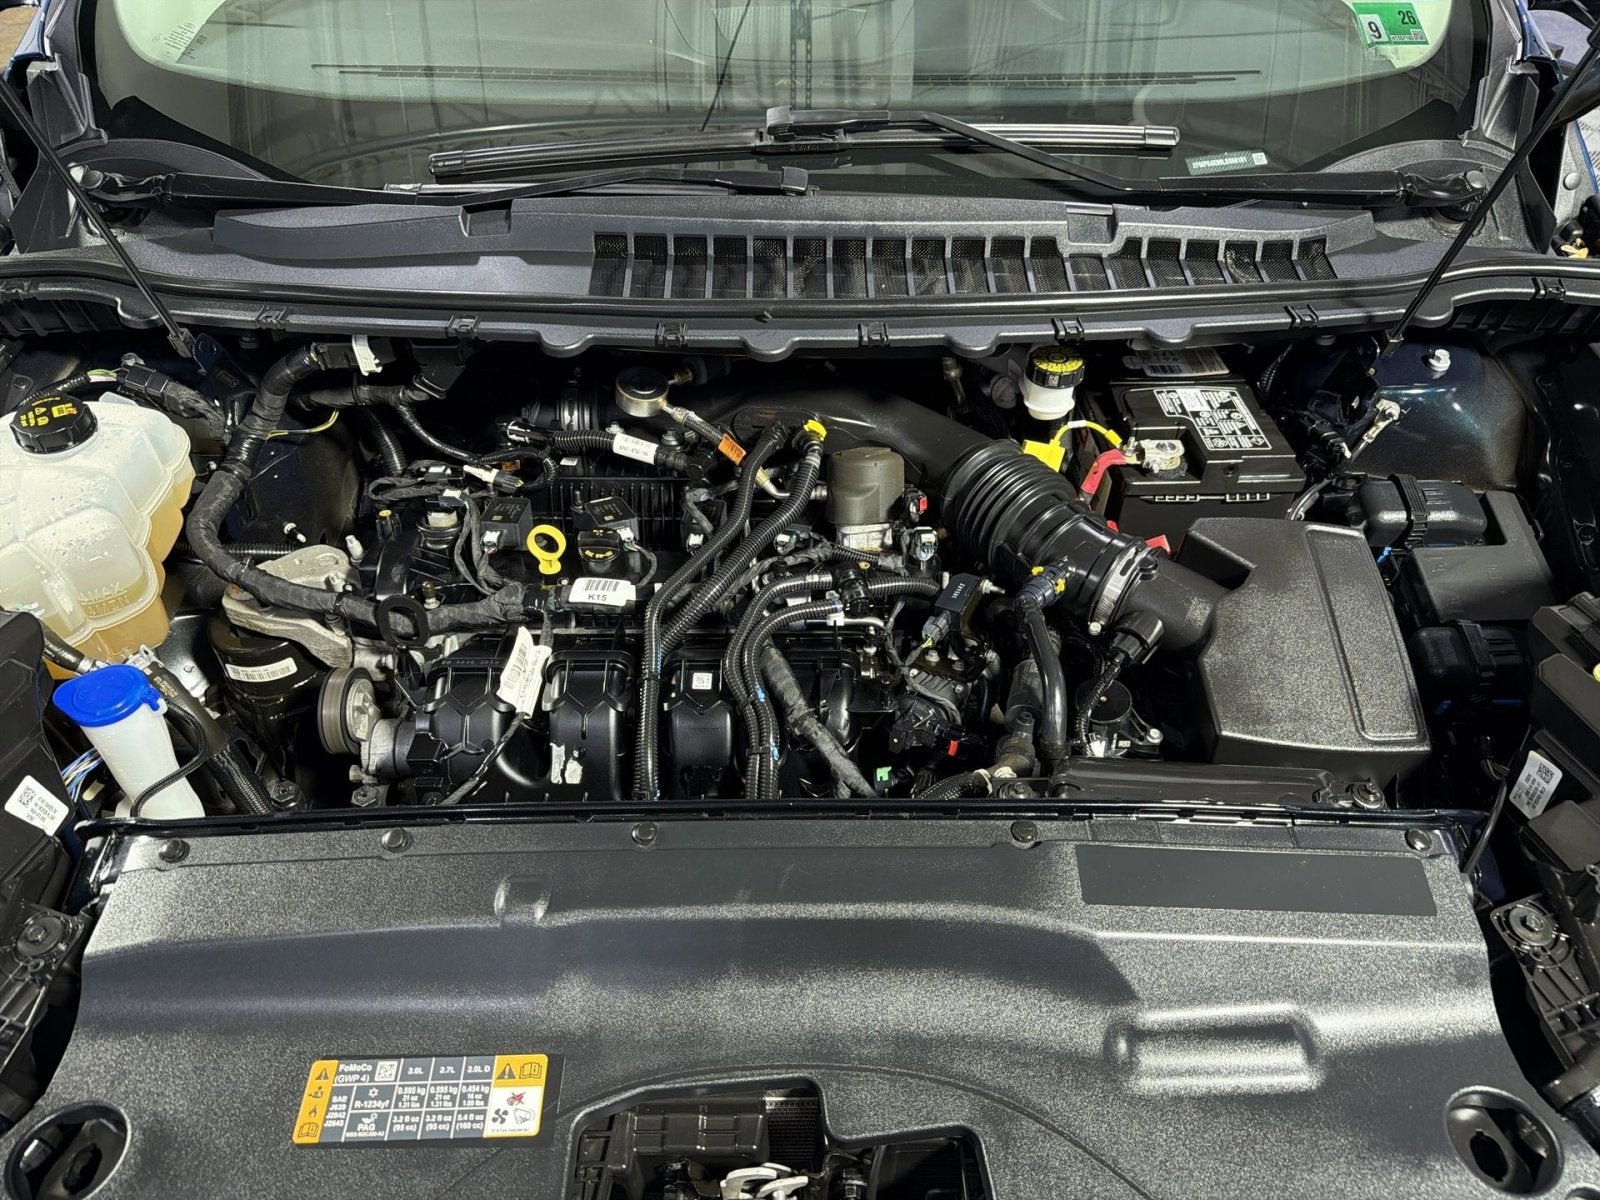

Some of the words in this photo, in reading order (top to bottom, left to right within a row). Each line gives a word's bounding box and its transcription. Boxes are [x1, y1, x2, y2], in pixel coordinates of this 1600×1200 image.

[1397, 9, 1417, 26] 26
[1367, 21, 1382, 40] 9
[339, 1064, 372, 1072] FoMoCo
[440, 1066, 455, 1074] 2.7L
[466, 1065, 483, 1073] 2.0L
[484, 1065, 491, 1073] D
[334, 1074, 360, 1084] (GWP
[361, 1074, 370, 1084] 4)
[417, 1087, 426, 1096] kg
[448, 1085, 458, 1095] kg
[479, 1085, 490, 1095] kg
[354, 1100, 390, 1110] R-1234yf
[392, 1115, 403, 1123] 3.2
[425, 1114, 437, 1122] 3.2
[357, 1123, 376, 1131] PAG
[405, 1123, 417, 1132] cc)
[439, 1122, 450, 1131] cc)
[472, 1122, 484, 1131] cc)
